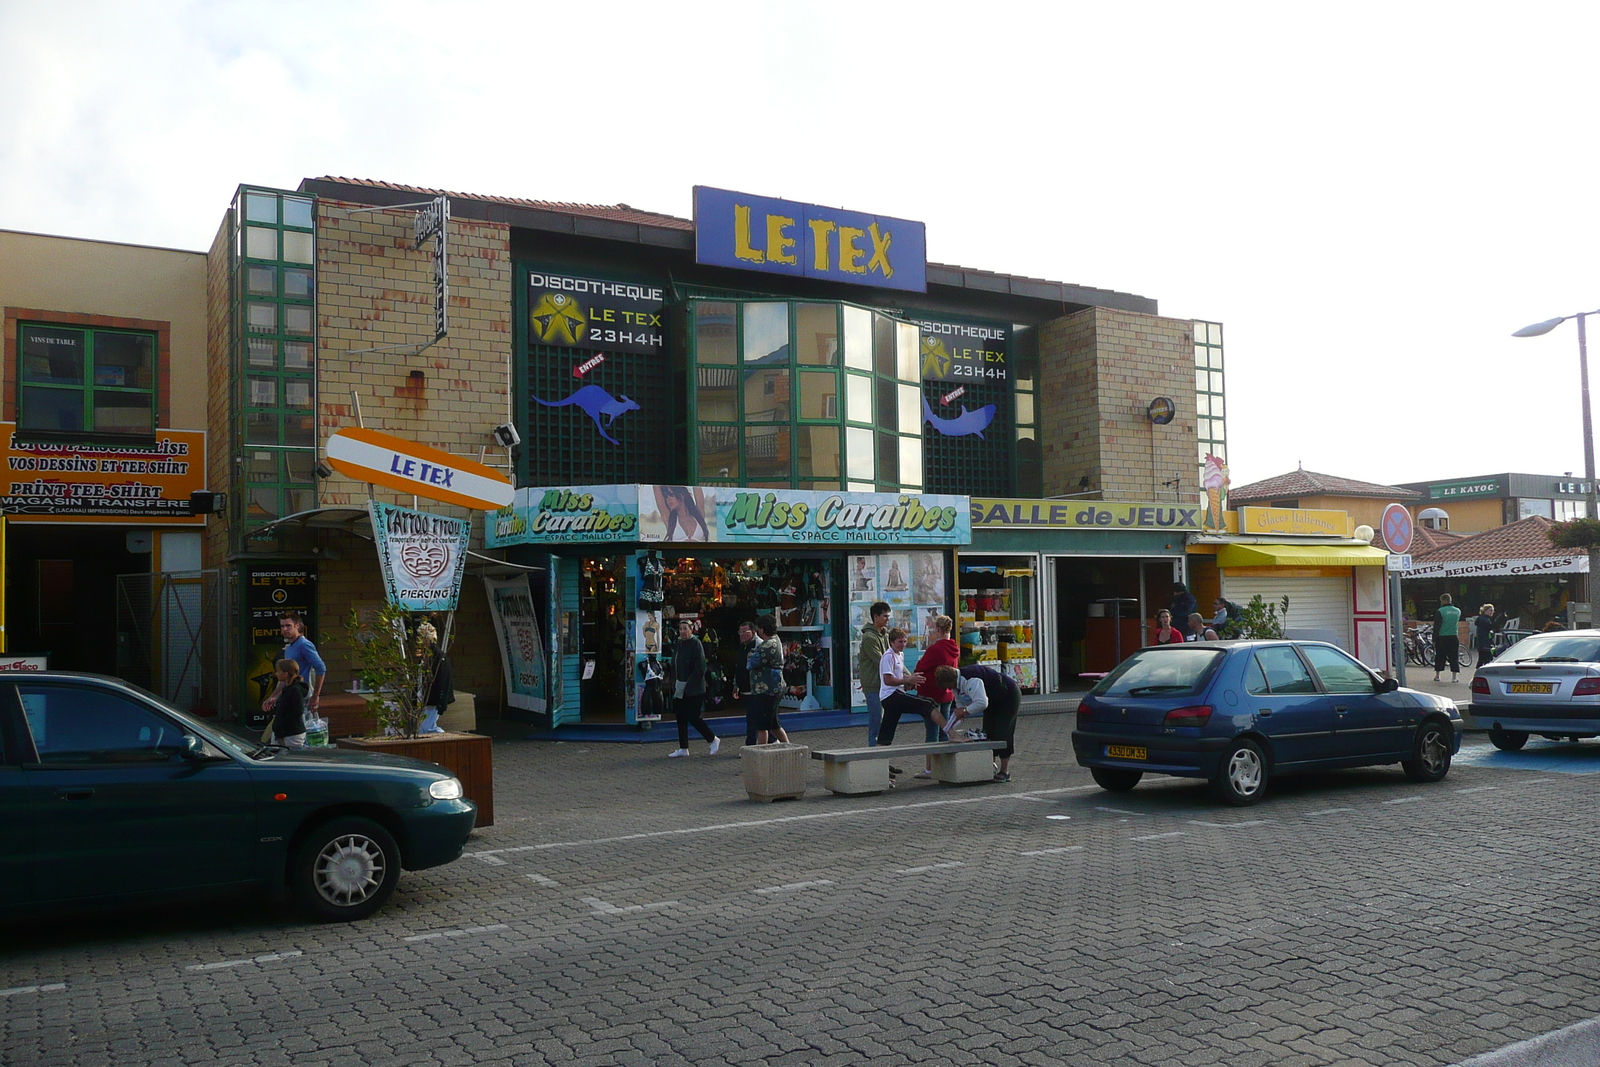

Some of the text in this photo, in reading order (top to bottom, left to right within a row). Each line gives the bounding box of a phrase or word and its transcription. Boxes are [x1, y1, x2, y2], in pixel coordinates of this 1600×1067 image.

[735, 204, 894, 279] LE TEX
[530, 274, 663, 301] DISCOTHEQUE
[589, 307, 662, 327] LE TEX
[30, 336, 46, 344] VINS
[56, 338, 76, 346] TABLE
[590, 328, 663, 346] 23H4H
[953, 347, 1005, 363] LE TEX
[953, 365, 1006, 380] 23H4H
[8, 457, 36, 470] VOS
[100, 460, 118, 472] ET
[120, 461, 146, 473] TEE
[390, 454, 455, 488] LE TEX
[9, 478, 67, 496] PRINT
[1444, 487, 1457, 495] LE
[1459, 484, 1495, 494] KAYOC
[1559, 482, 1575, 493] LE
[1, 497, 190, 508] MAGASIN TRANSFERE
[537, 489, 594, 512] Miss
[724, 492, 810, 530] Miss
[971, 503, 1197, 527] SALLE de JEUX
[1257, 510, 1289, 528] Glaces
[1292, 509, 1337, 531] Italiennes
[384, 507, 430, 536] TATTOO
[582, 533, 622, 541] MAILLOTS
[792, 531, 900, 541] ESPACE MAILLOTS
[1445, 561, 1508, 577] BEIGNETS
[1510, 558, 1572, 574] GLACES
[252, 577, 271, 586] LE
[276, 577, 306, 586] TEX
[400, 589, 449, 599] PIERCING
